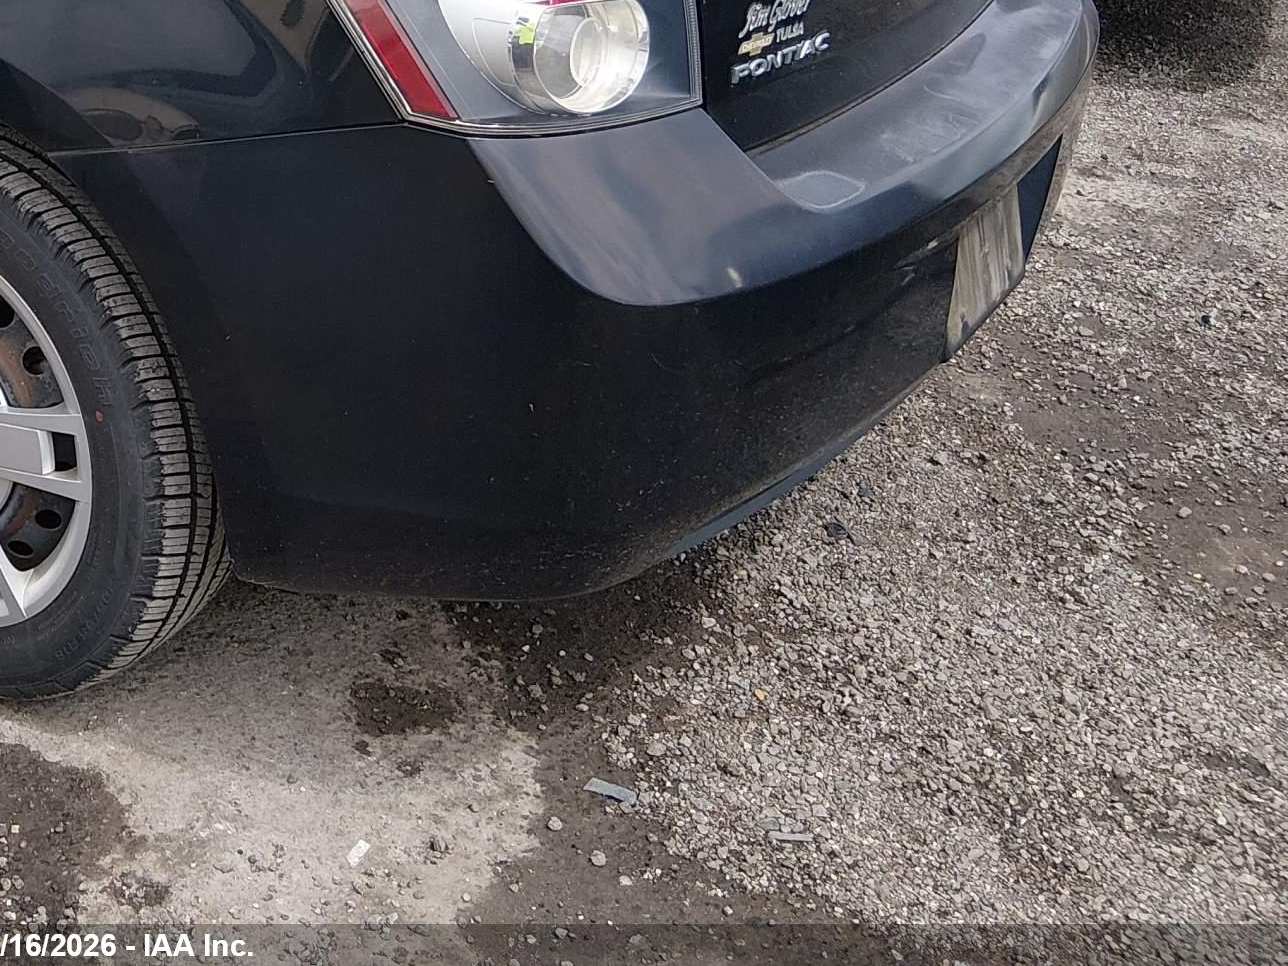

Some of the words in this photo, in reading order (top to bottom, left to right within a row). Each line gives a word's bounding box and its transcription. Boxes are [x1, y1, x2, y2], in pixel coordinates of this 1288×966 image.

[738, 1, 772, 39] Jim
[776, 21, 804, 42] TULSA
[731, 30, 830, 84] PONTIAC
